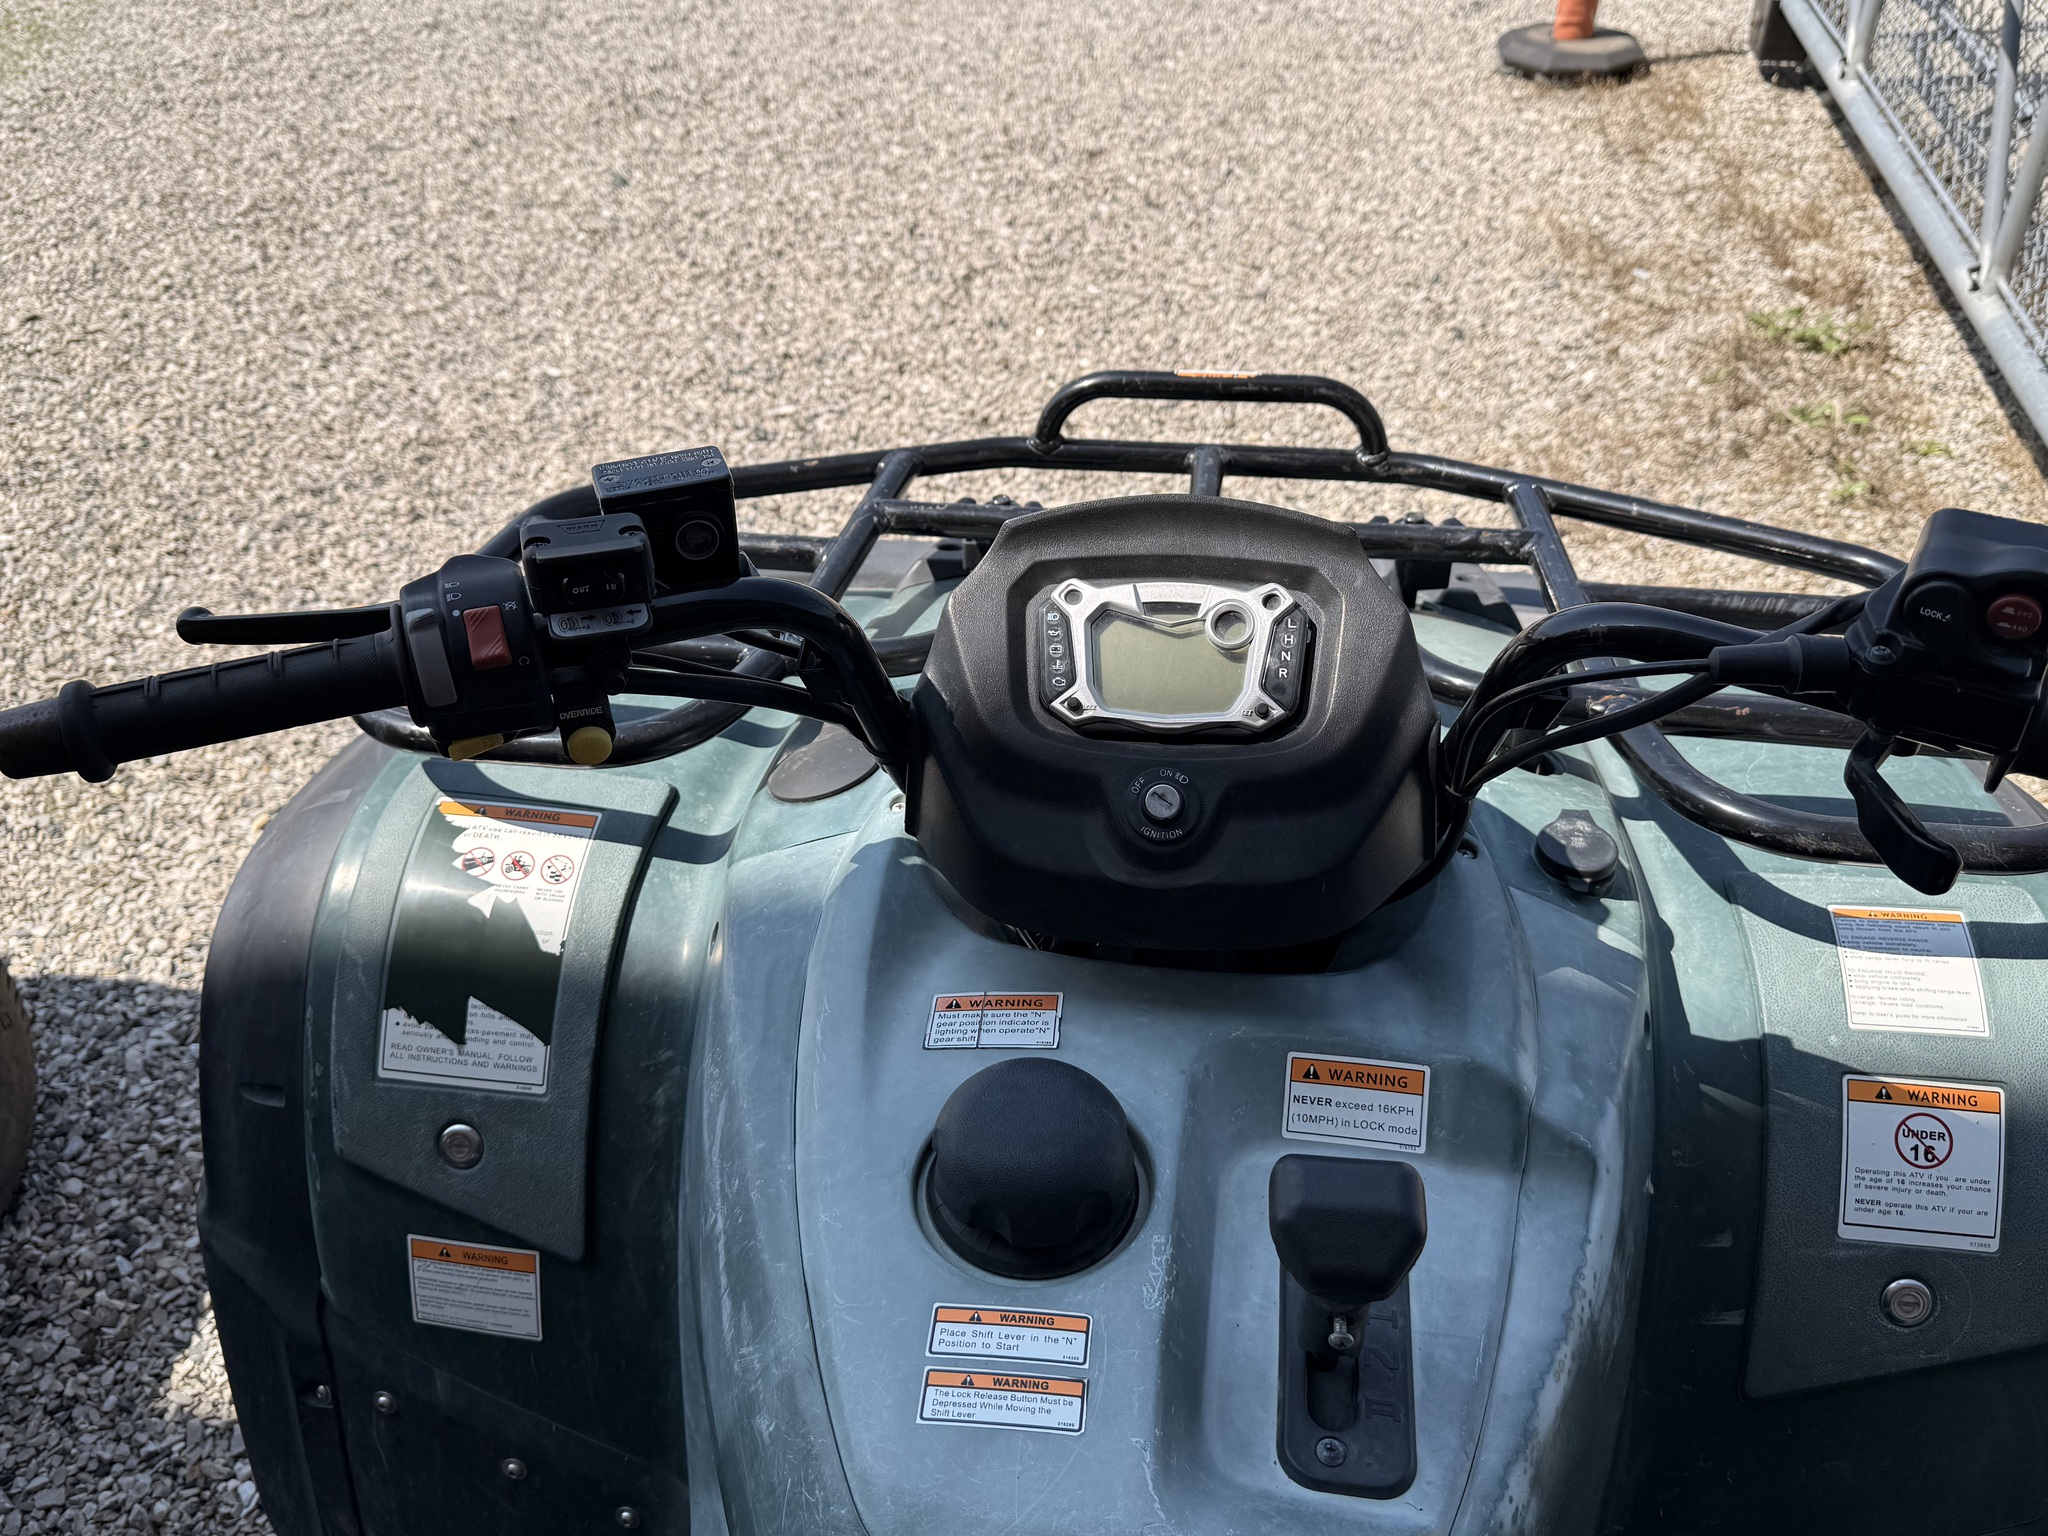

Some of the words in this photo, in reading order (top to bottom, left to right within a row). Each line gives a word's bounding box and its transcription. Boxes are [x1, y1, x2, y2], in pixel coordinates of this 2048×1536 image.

[572, 585, 590, 594] OUT
[606, 583, 617, 591] IN
[1920, 607, 1943, 620] LOCK
[1288, 618, 1297, 628] L
[1284, 634, 1294, 645] H
[1281, 651, 1291, 661] N
[1279, 668, 1288, 678] R
[560, 706, 603, 720] OVERRIDE
[1132, 777, 1144, 793] OFF
[505, 808, 561, 821] WARNING
[1141, 826, 1182, 838] IGNITION
[969, 999, 1043, 1007] WARNING
[402, 1030, 433, 1039] seriously
[391, 1043, 413, 1051] READ
[417, 1046, 454, 1055] OWNER'S
[498, 1054, 533, 1063] FOLLOW
[408, 1054, 468, 1066] INSTRUCTIONS
[493, 1062, 539, 1072] WARNINGS.
[1328, 1068, 1408, 1088] WARNING
[1907, 1089, 1978, 1107] WARNING
[1293, 1095, 1332, 1106] NEVER
[1335, 1101, 1374, 1112] exceed
[1378, 1104, 1414, 1116] 16KPH
[1291, 1114, 1338, 1127] (10MPH)
[1341, 1118, 1350, 1127] in
[1353, 1120, 1385, 1131] LOCK
[1388, 1125, 1418, 1135] mode
[1902, 1128, 1946, 1141] UNDER
[1910, 1144, 1936, 1163] 16
[1855, 1167, 1890, 1177] Operating
[1891, 1185, 1911, 1194] injury
[1926, 1189, 1948, 1197] death.
[1908, 1179, 1943, 1188] increases
[1946, 1183, 1962, 1191] your
[1966, 1185, 1991, 1193] chance
[1854, 1198, 1881, 1206] NEVER
[1885, 1201, 1912, 1210] operate
[463, 1251, 508, 1264] WARNING
[1000, 1314, 1055, 1326] WARNING
[940, 1328, 966, 1337] Place
[971, 1330, 993, 1339] Shift
[998, 1332, 1026, 1341] Lever
[1031, 1334, 1039, 1342] in
[1044, 1335, 1059, 1344] the
[938, 1339, 977, 1348] Position
[996, 1342, 1020, 1351] Start
[993, 1378, 1050, 1390] WARNING
[934, 1389, 949, 1397] The
[952, 1390, 971, 1399] Lock
[974, 1391, 1008, 1401] Release
[1010, 1394, 1038, 1403] Button
[1040, 1397, 1061, 1405] Must
[931, 1409, 950, 1417] Shift
[932, 1399, 977, 1409] Depressed
[979, 1402, 1003, 1410] While
[1005, 1404, 1036, 1414] Moving
[1039, 1406, 1052, 1414] the
